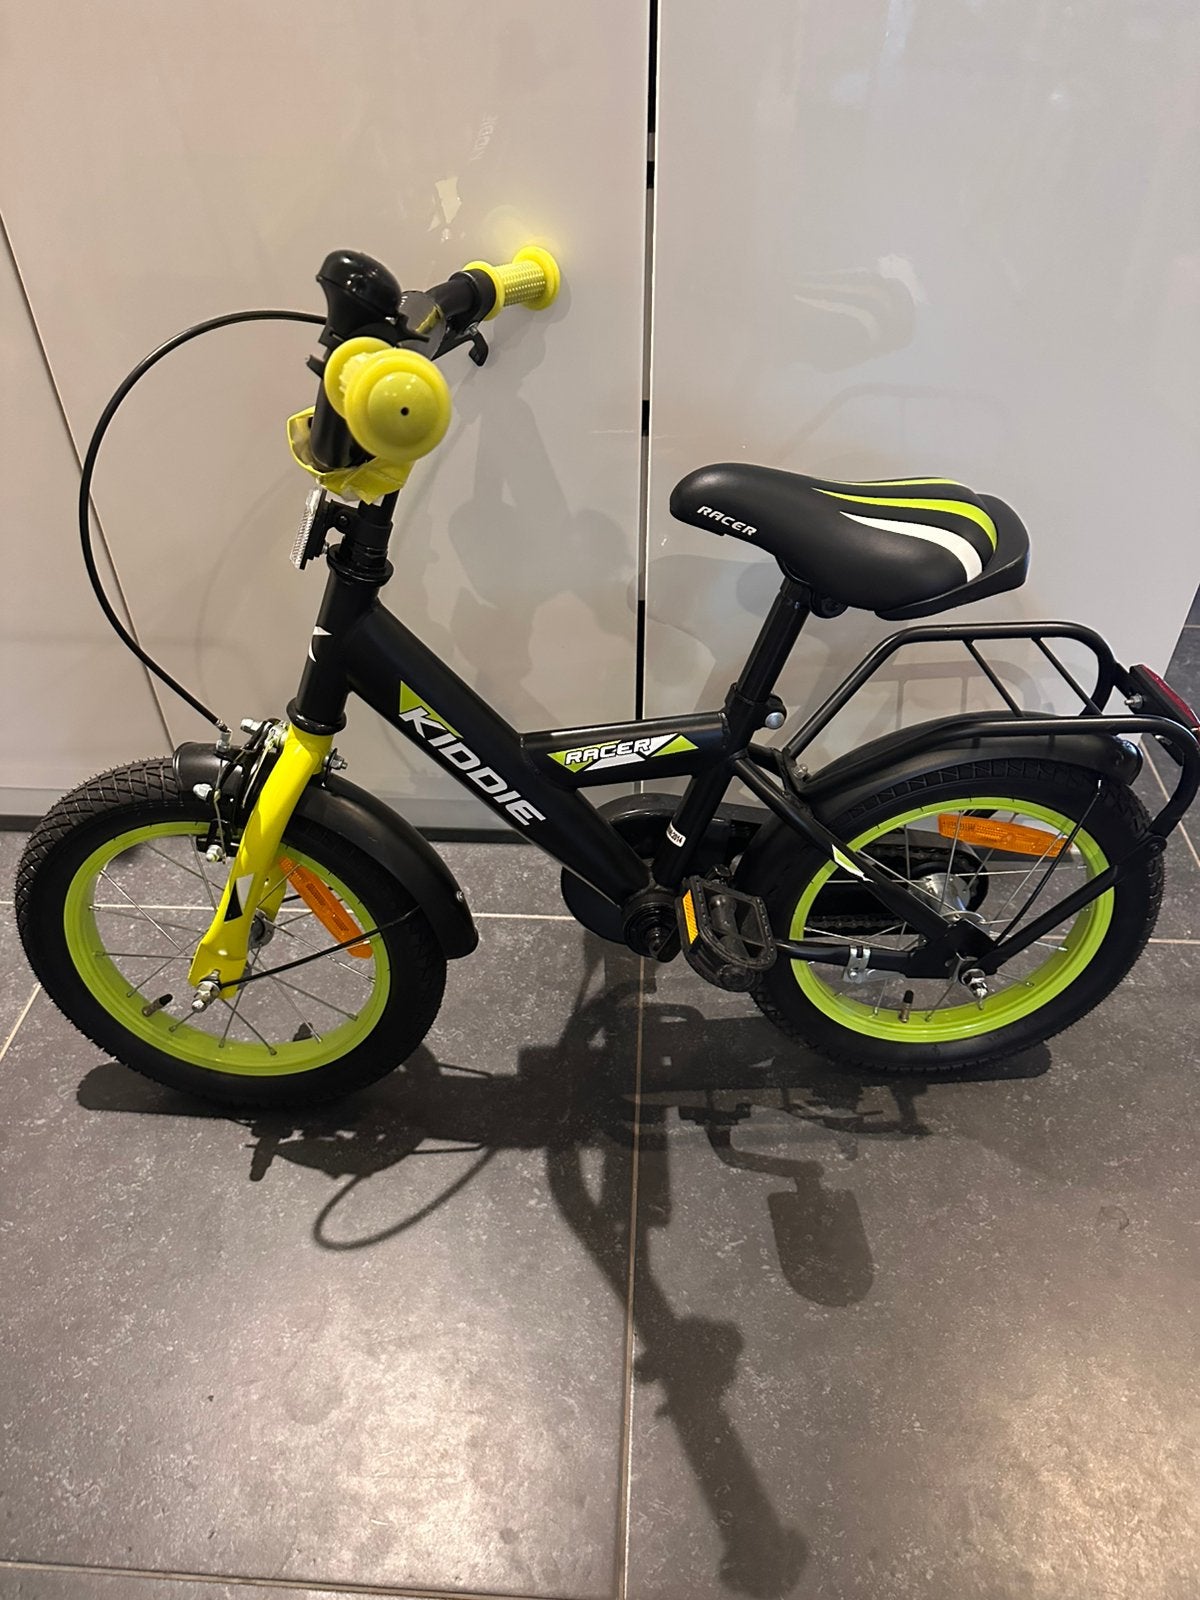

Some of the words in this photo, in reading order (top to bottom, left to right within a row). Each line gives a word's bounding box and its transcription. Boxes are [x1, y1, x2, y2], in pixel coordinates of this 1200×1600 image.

[696, 505, 758, 536] RACER
[398, 705, 547, 826] KIDDIE
[565, 738, 652, 765] RACER
